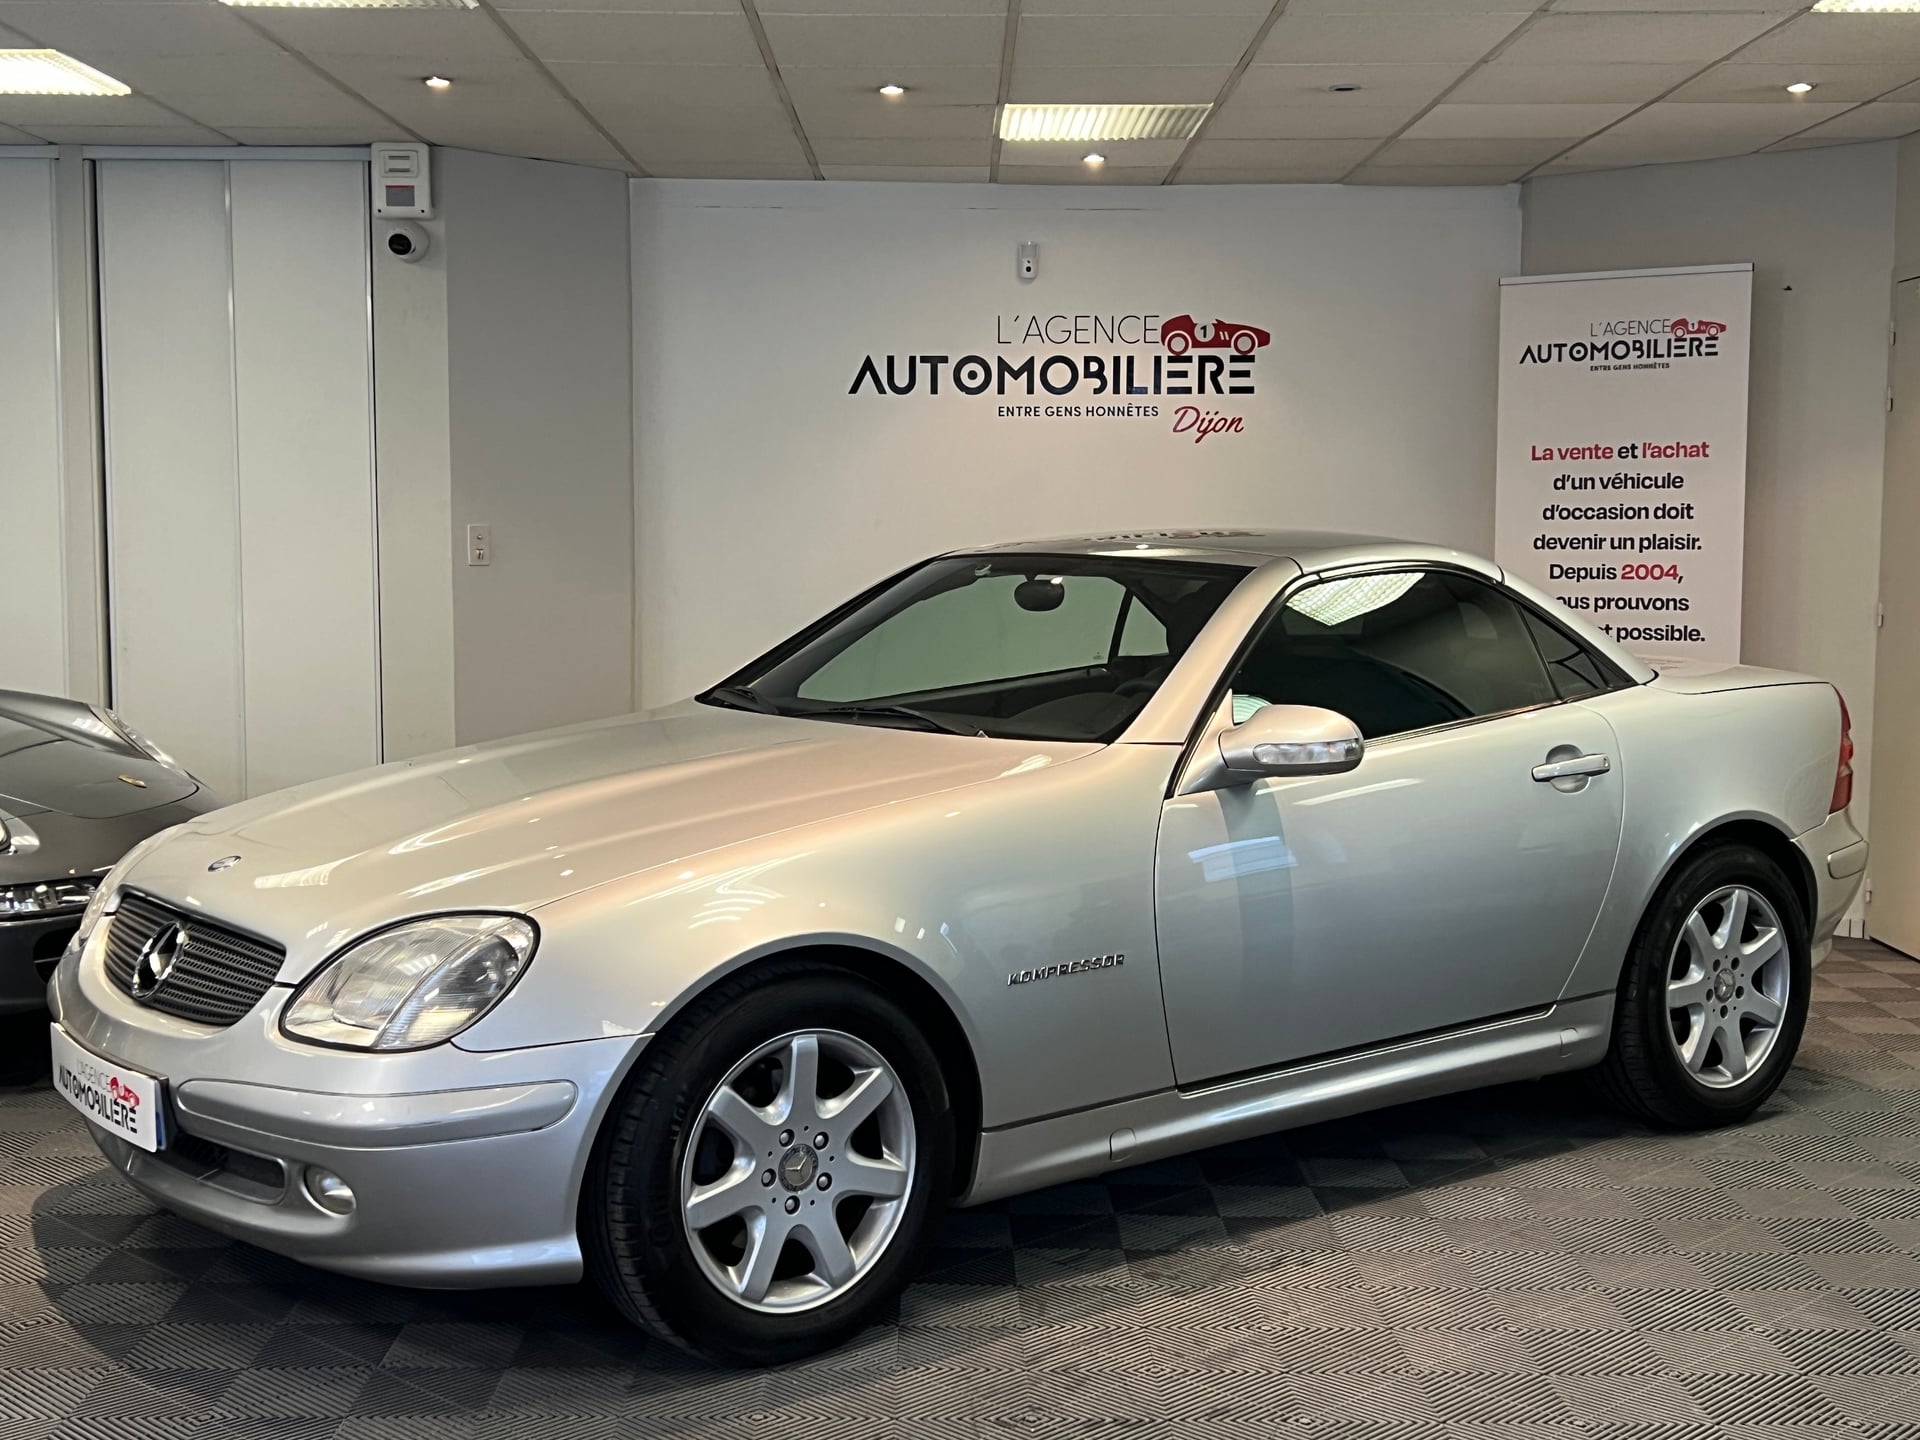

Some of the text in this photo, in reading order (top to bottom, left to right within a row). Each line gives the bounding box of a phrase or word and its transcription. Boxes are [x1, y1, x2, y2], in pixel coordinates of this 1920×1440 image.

[997, 315, 1160, 345] L'AGENCE
[1590, 318, 1671, 337] L'AGENCE
[1590, 364, 1611, 372] ENTRE
[998, 402, 1159, 417] ENTRE GENS HONNÊTES
[1172, 405, 1244, 443] Dijon
[1531, 441, 1710, 461] La vente et l'achat
[1553, 472, 1684, 490] d'un véhicule
[1542, 503, 1694, 520] d'occasion doit
[1533, 533, 1702, 553] devenir un plaisir.
[1549, 563, 1683, 583] Depuis 2004,
[1594, 596, 1689, 612] prouvons
[1616, 625, 1706, 642] possible.
[1007, 953, 1125, 986] KOMPRESSOR
